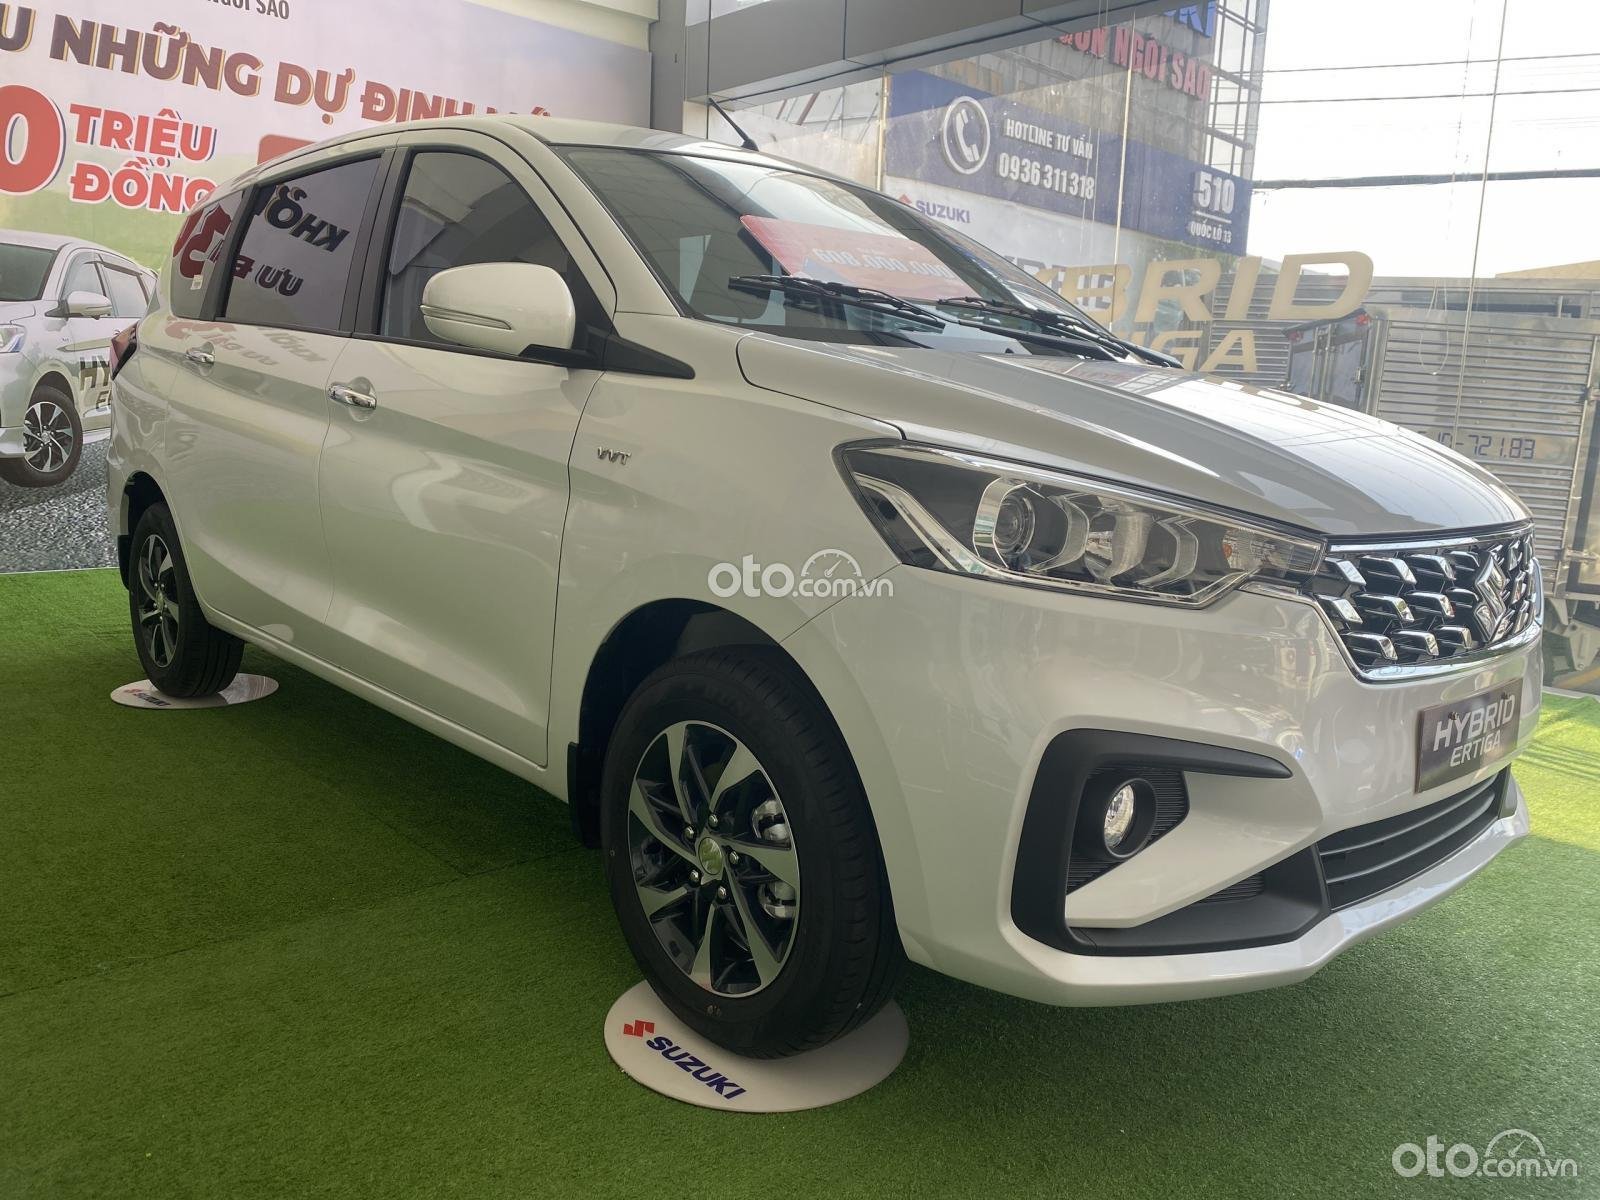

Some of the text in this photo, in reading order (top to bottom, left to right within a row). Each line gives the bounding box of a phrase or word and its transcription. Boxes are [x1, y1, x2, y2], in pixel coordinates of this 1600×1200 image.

[256, 0, 289, 19] SAO
[50, 14, 263, 97] NHỮNG
[274, 61, 356, 126] DỰ
[1113, 25, 1168, 81] NGÔI
[1171, 50, 1212, 100] SAO
[69, 102, 217, 167] TRIỆU
[1006, 118, 1053, 148] HOTLINE
[1056, 133, 1071, 152] TƯ
[999, 152, 1040, 186] 0936
[915, 199, 971, 224] SUZUKI
[1197, 171, 1235, 214] 510
[1036, 251, 1374, 326] BRID
[597, 446, 632, 466] VVT
[1432, 694, 1516, 752] HYBRID
[1450, 729, 1501, 768] ERTIGA
[646, 1036, 747, 1100] SUZUKI
